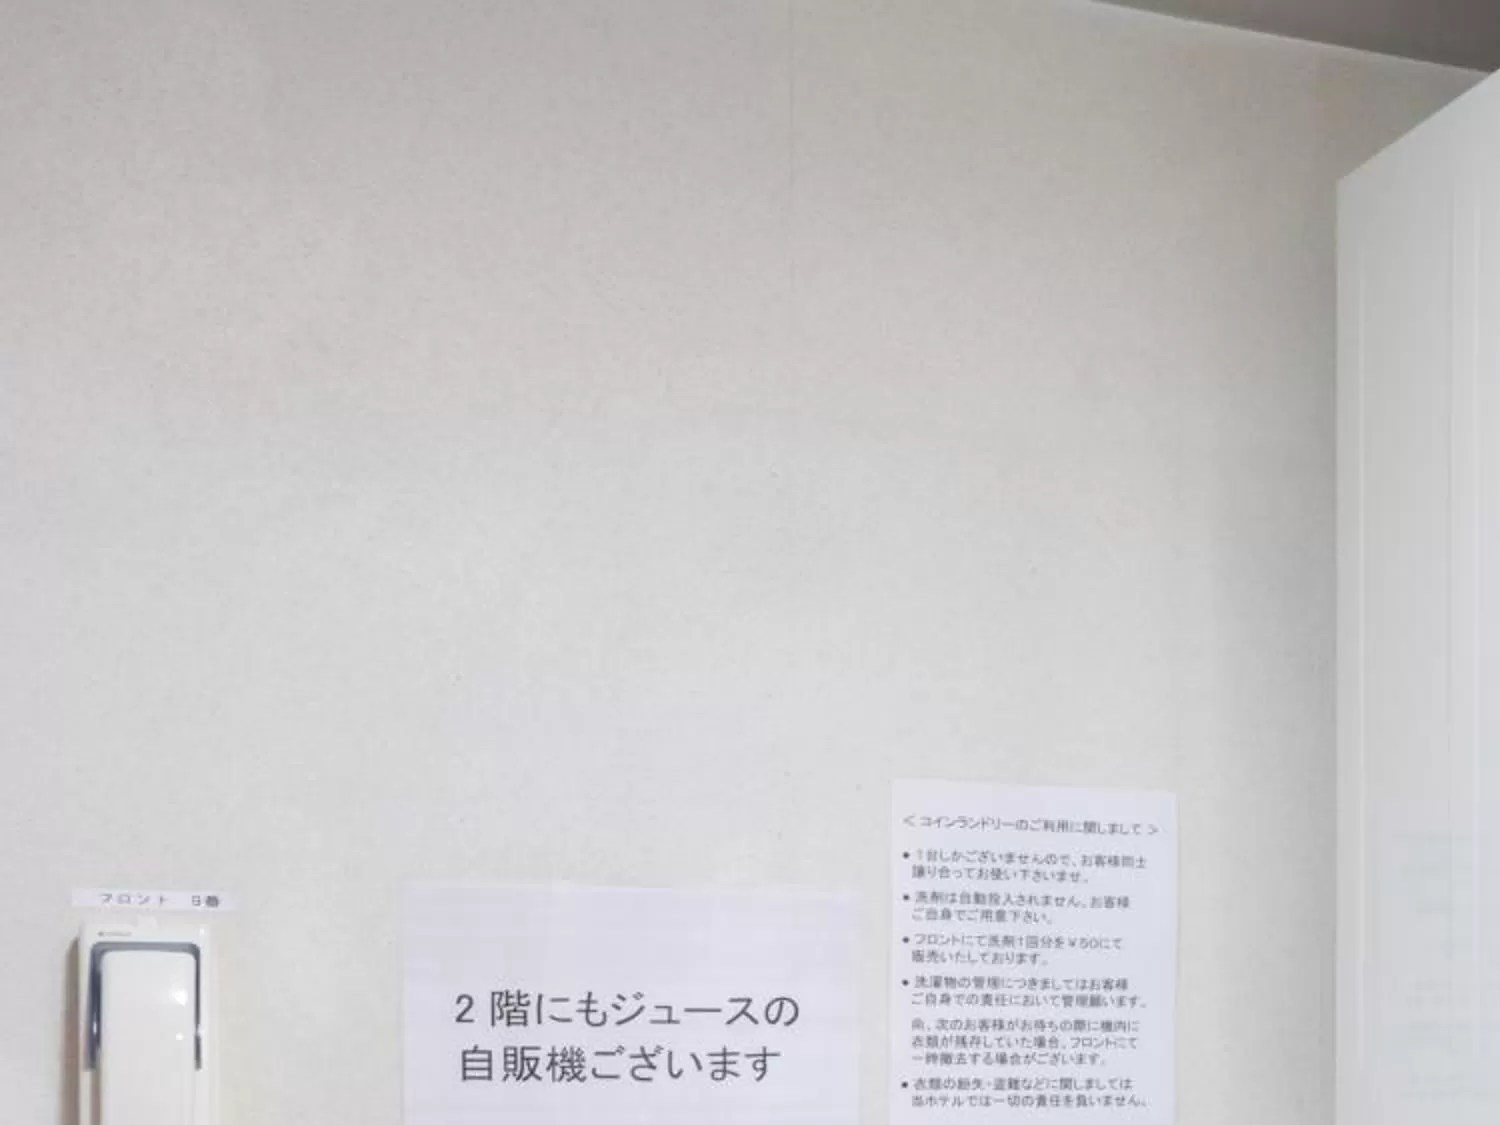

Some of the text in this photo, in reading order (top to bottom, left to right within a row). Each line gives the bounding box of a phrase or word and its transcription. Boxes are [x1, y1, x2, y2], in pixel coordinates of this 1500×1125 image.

[101, 893, 168, 906] フロント
[460, 1044, 783, 1084] 自販機ございます
